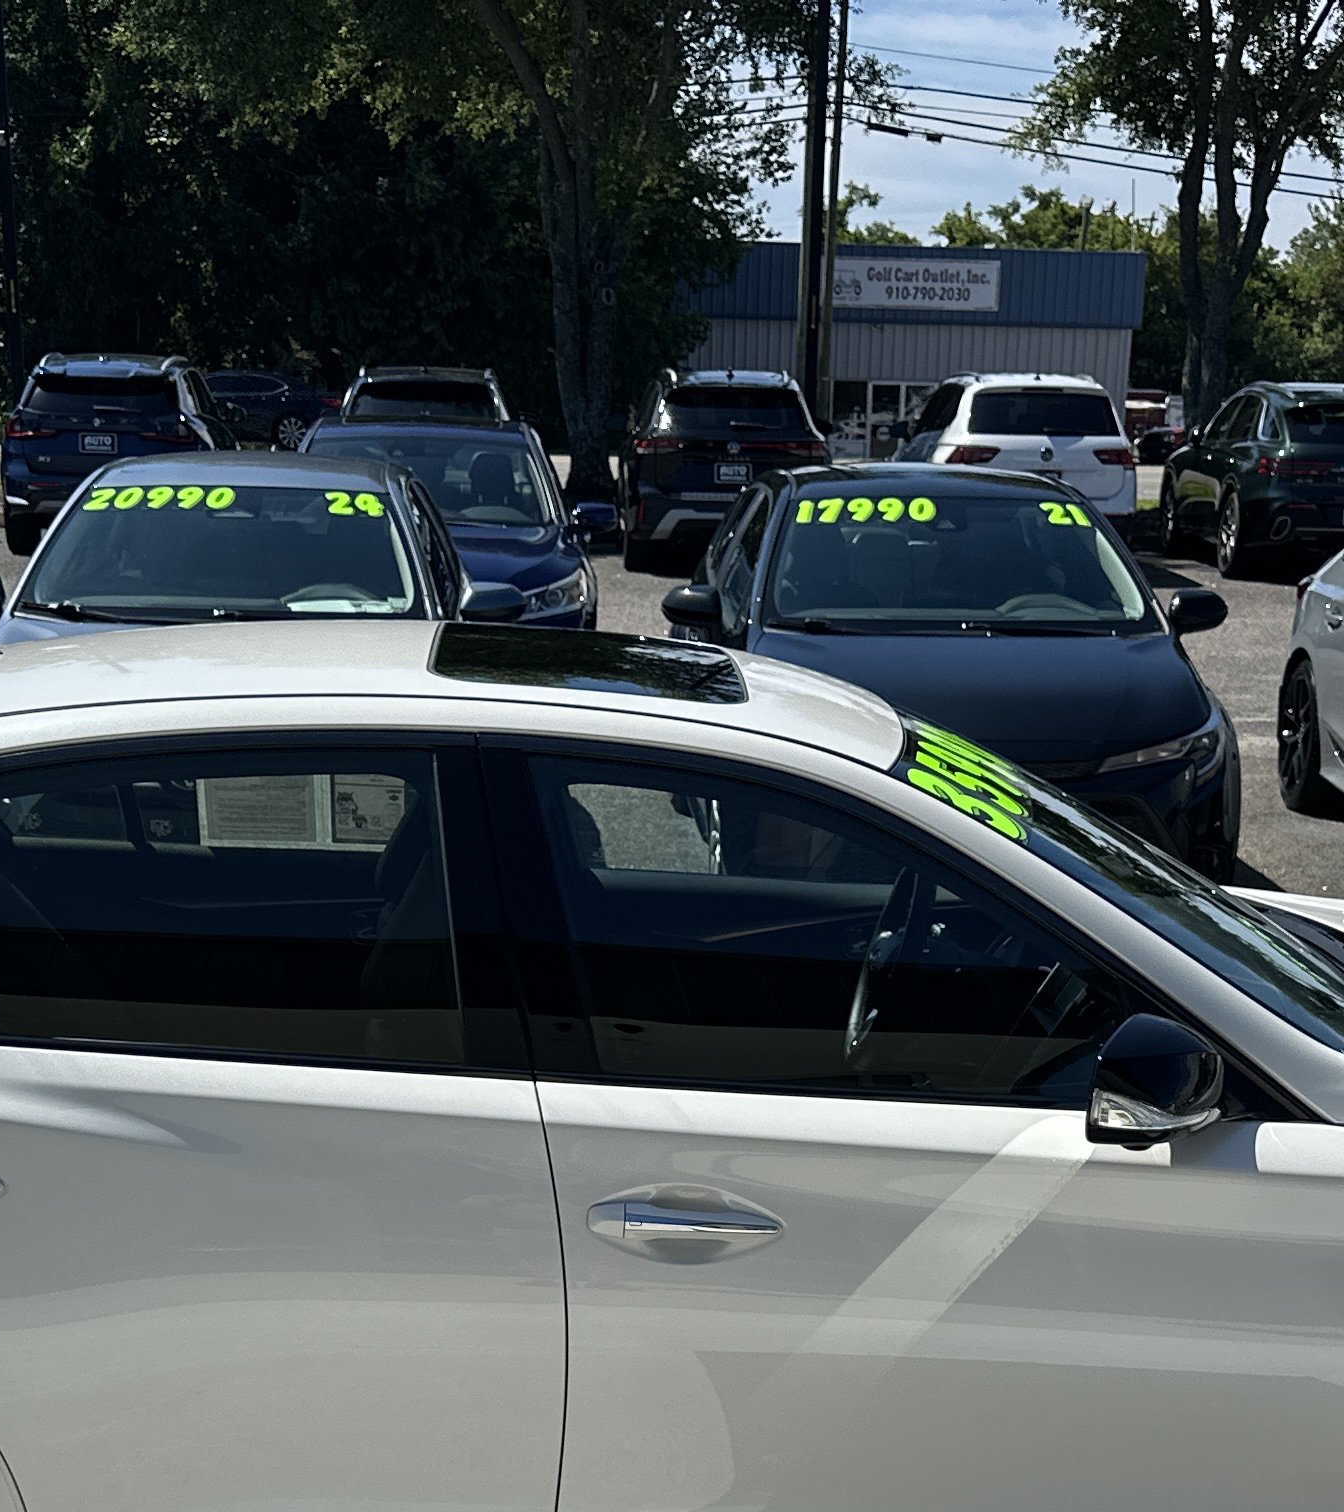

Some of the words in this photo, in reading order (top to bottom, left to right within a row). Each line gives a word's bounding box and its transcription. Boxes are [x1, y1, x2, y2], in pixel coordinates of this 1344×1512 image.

[866, 266, 893, 282] Golf
[895, 267, 920, 283] Cart
[922, 268, 965, 286] Outlet,
[967, 268, 991, 285] Inc.
[885, 285, 971, 301] 910-790-2030
[84, 436, 112, 446] AUTO
[83, 486, 236, 512] 20990
[325, 490, 385, 518] 24
[795, 497, 937, 524] 17990
[1040, 502, 1092, 528] 21
